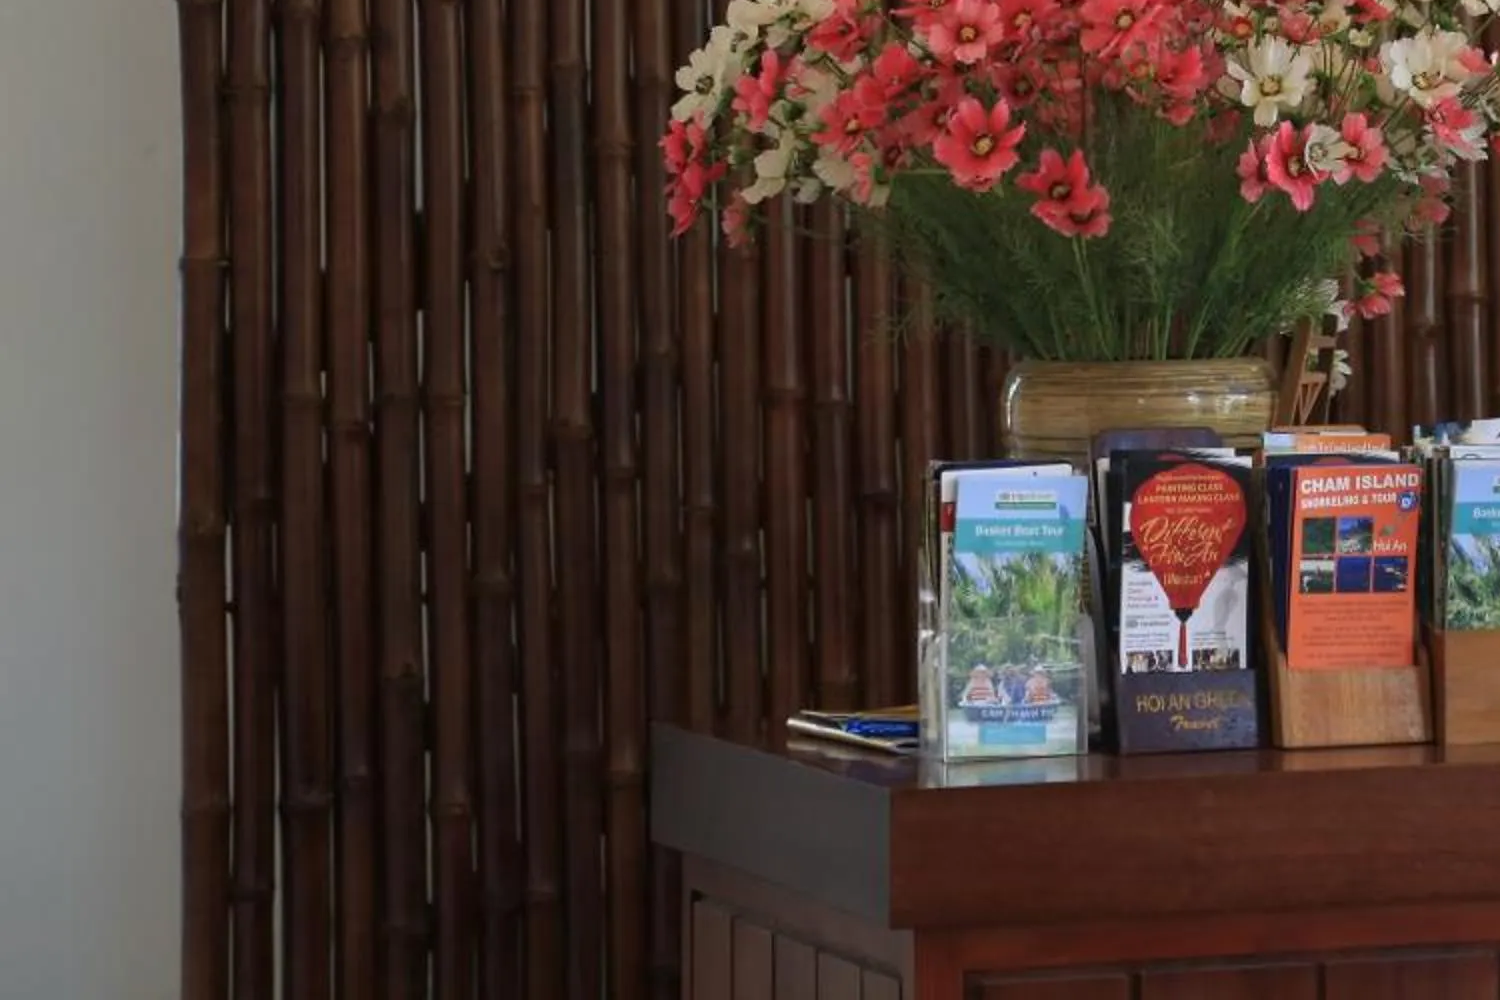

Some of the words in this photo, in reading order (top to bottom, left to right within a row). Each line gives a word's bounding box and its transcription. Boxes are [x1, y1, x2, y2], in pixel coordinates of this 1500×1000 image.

[1301, 475, 1350, 495] CHAM
[1355, 473, 1419, 490] ISLAND
[1167, 693, 1191, 711] AN
